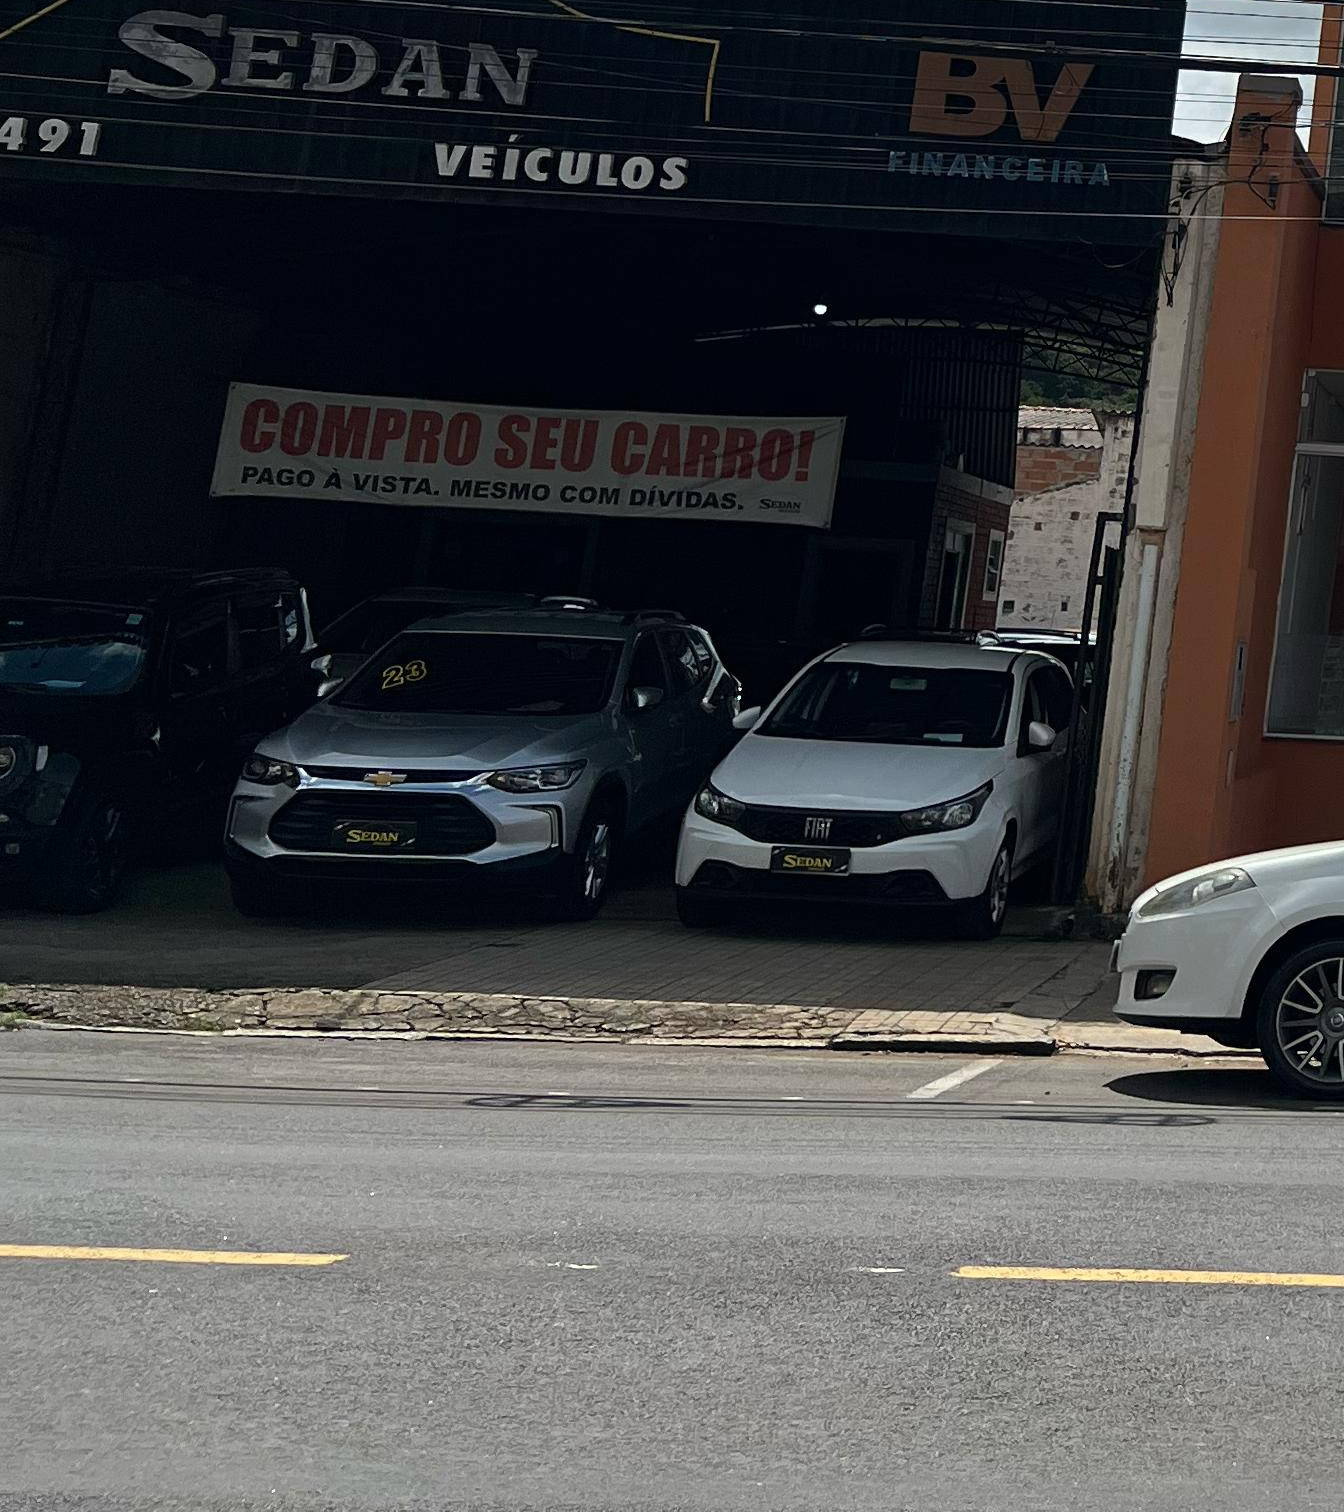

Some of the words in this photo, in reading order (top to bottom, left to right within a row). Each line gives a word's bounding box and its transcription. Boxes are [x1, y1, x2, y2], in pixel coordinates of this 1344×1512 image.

[107, 9, 541, 107] SEDAN
[908, 50, 1096, 143] BV
[0, 116, 102, 156] 491
[434, 133, 690, 191] VEÍCULOS
[887, 150, 1111, 187] FINANCEIRA
[239, 398, 482, 467] COMPRO
[494, 414, 600, 473] SEU
[610, 421, 816, 482] CARRO!
[240, 465, 315, 488] PAGO
[323, 467, 342, 489] À
[353, 473, 440, 497] VISTA.
[449, 479, 551, 502] MESMO
[559, 485, 620, 506] COM
[629, 485, 744, 512] DÍVIDAS.
[760, 498, 801, 510] SEDAN
[381, 659, 428, 690] 23
[346, 829, 399, 843] SEDAN
[804, 816, 833, 840] FIAT
[783, 854, 832, 868] SEDAN
